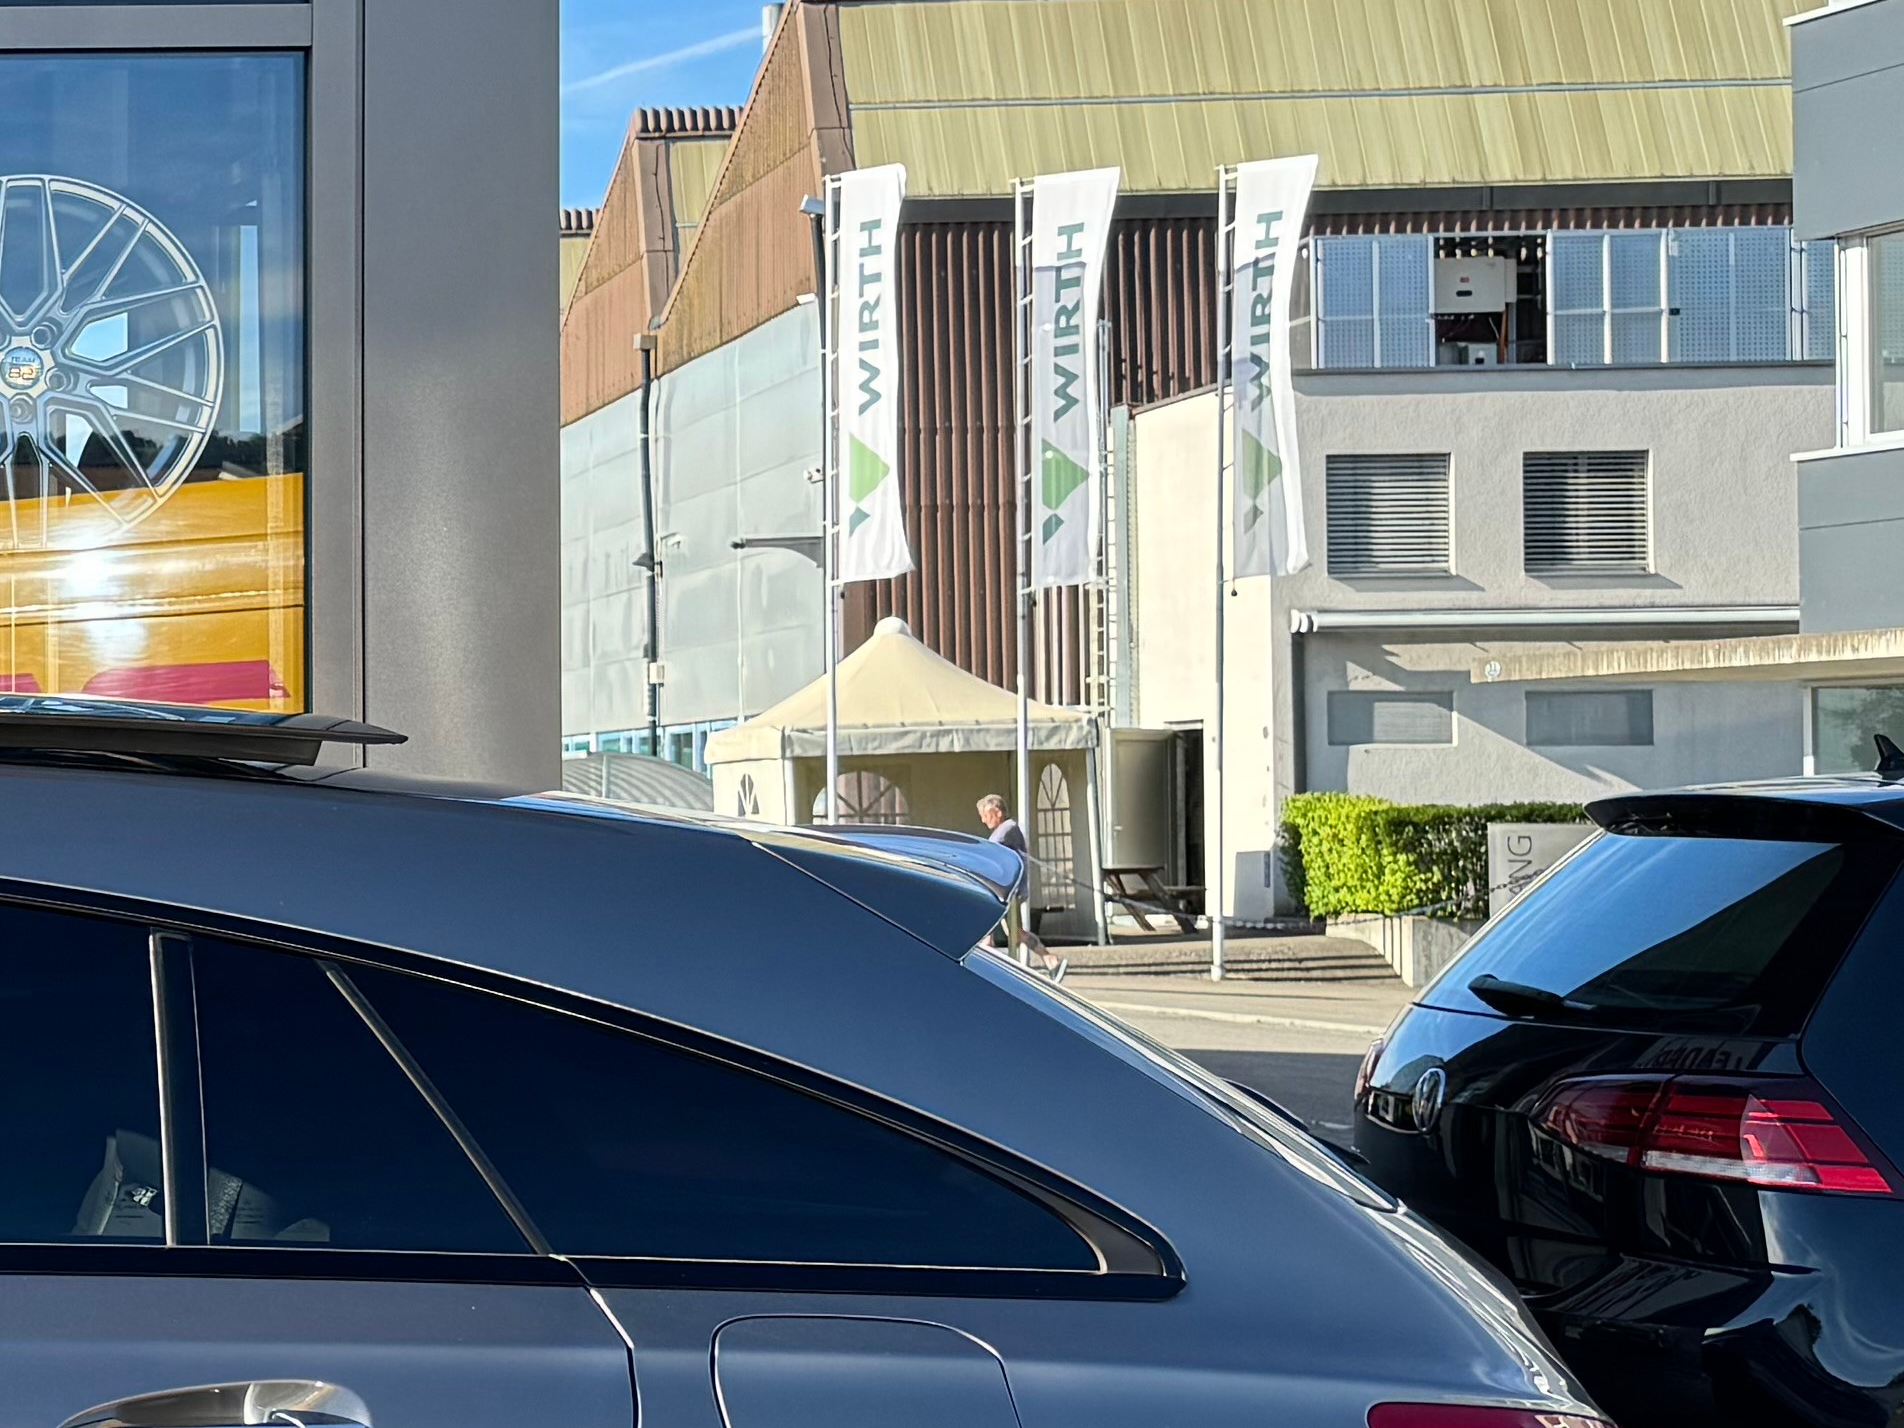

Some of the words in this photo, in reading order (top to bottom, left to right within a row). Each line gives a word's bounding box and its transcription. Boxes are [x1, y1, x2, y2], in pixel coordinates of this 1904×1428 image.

[857, 218, 882, 416] WIRTH
[1052, 221, 1085, 423] WIRTH
[1248, 210, 1283, 412] WIRTH
